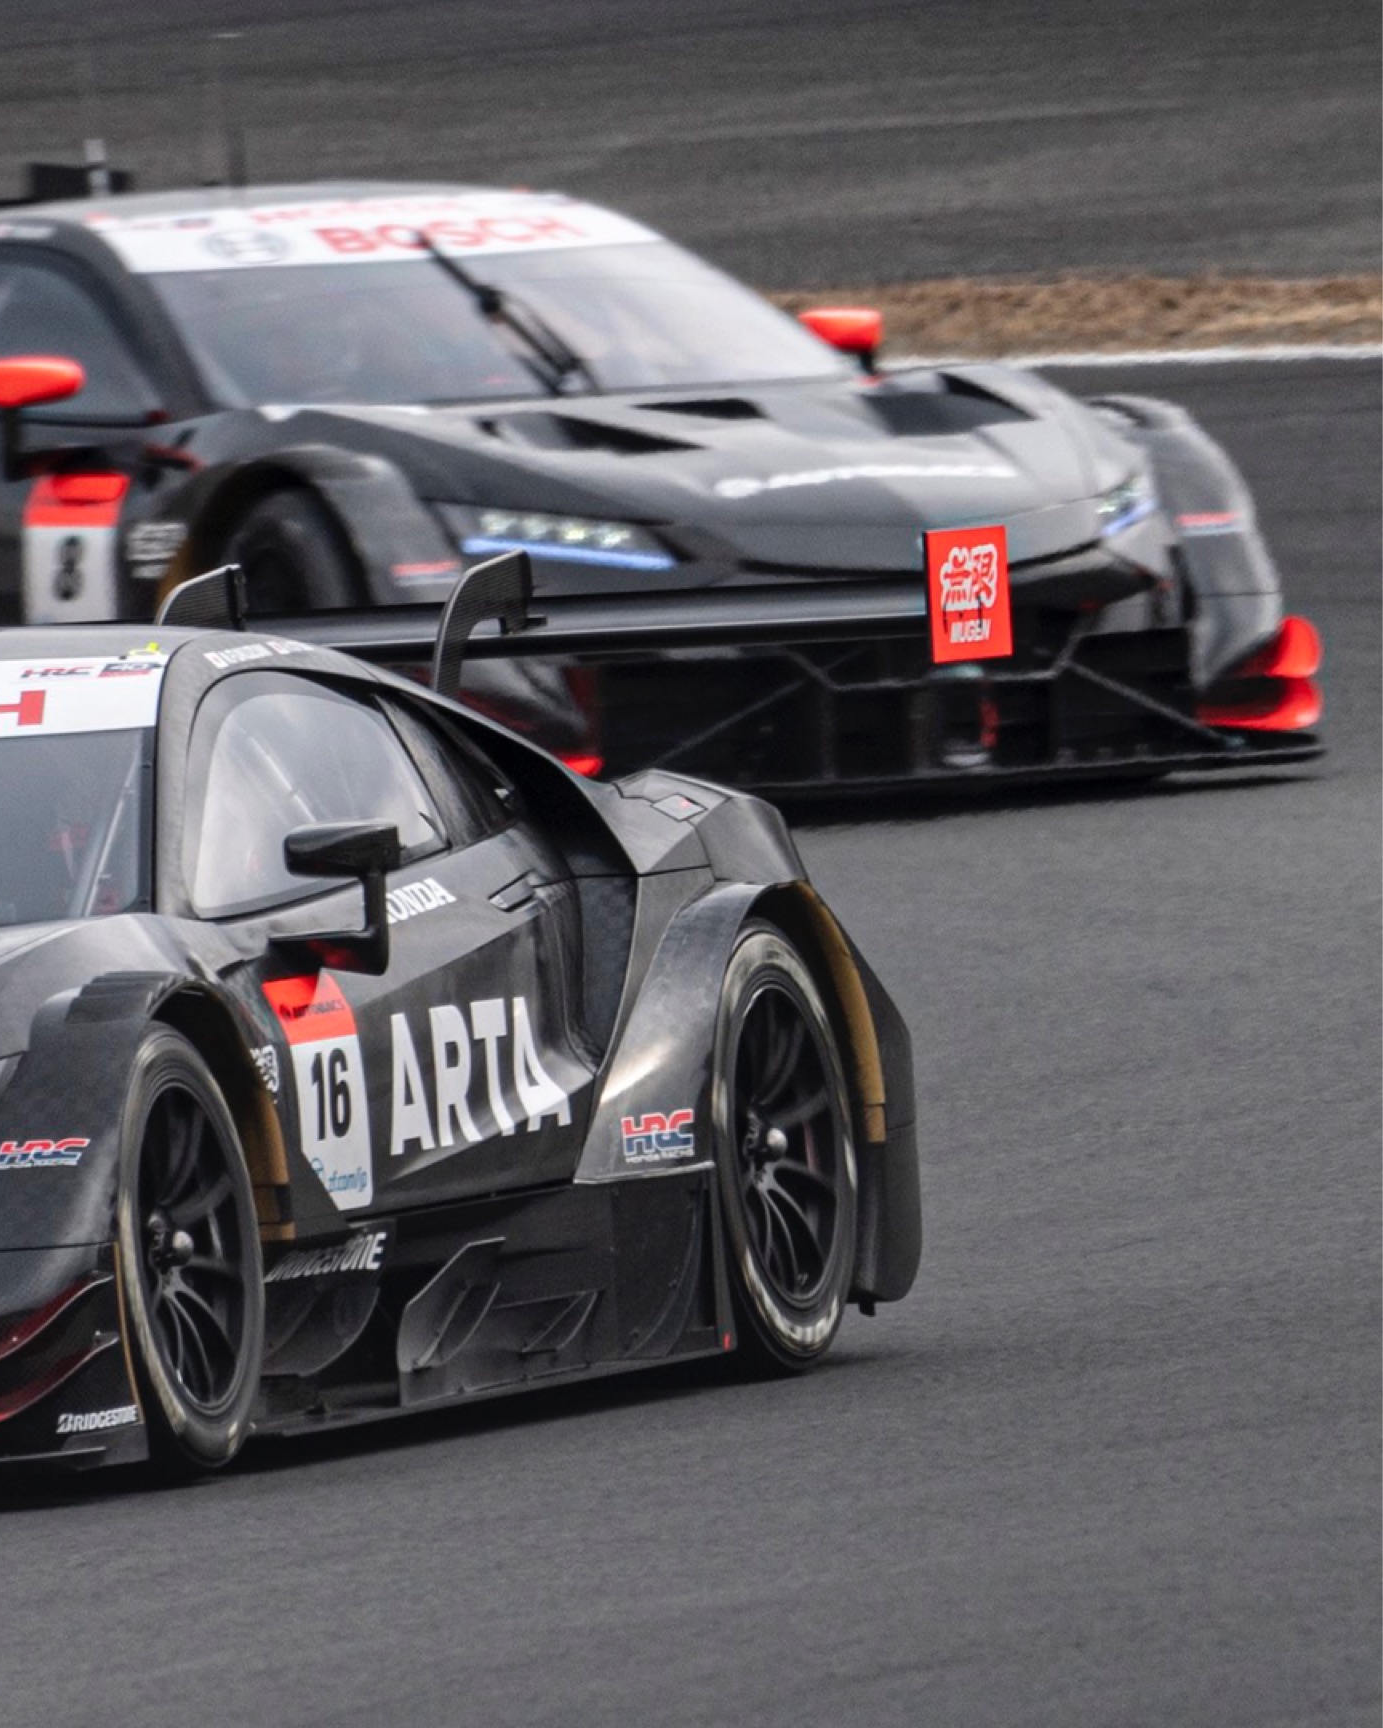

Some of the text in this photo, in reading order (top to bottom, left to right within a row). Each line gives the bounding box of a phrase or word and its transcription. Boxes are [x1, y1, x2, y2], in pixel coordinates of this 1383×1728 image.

[317, 214, 590, 255] BOSCH
[52, 535, 85, 602] 8
[310, 1047, 352, 1142] 16
[389, 996, 573, 1156] ARTA
[621, 1109, 694, 1156] HRC
